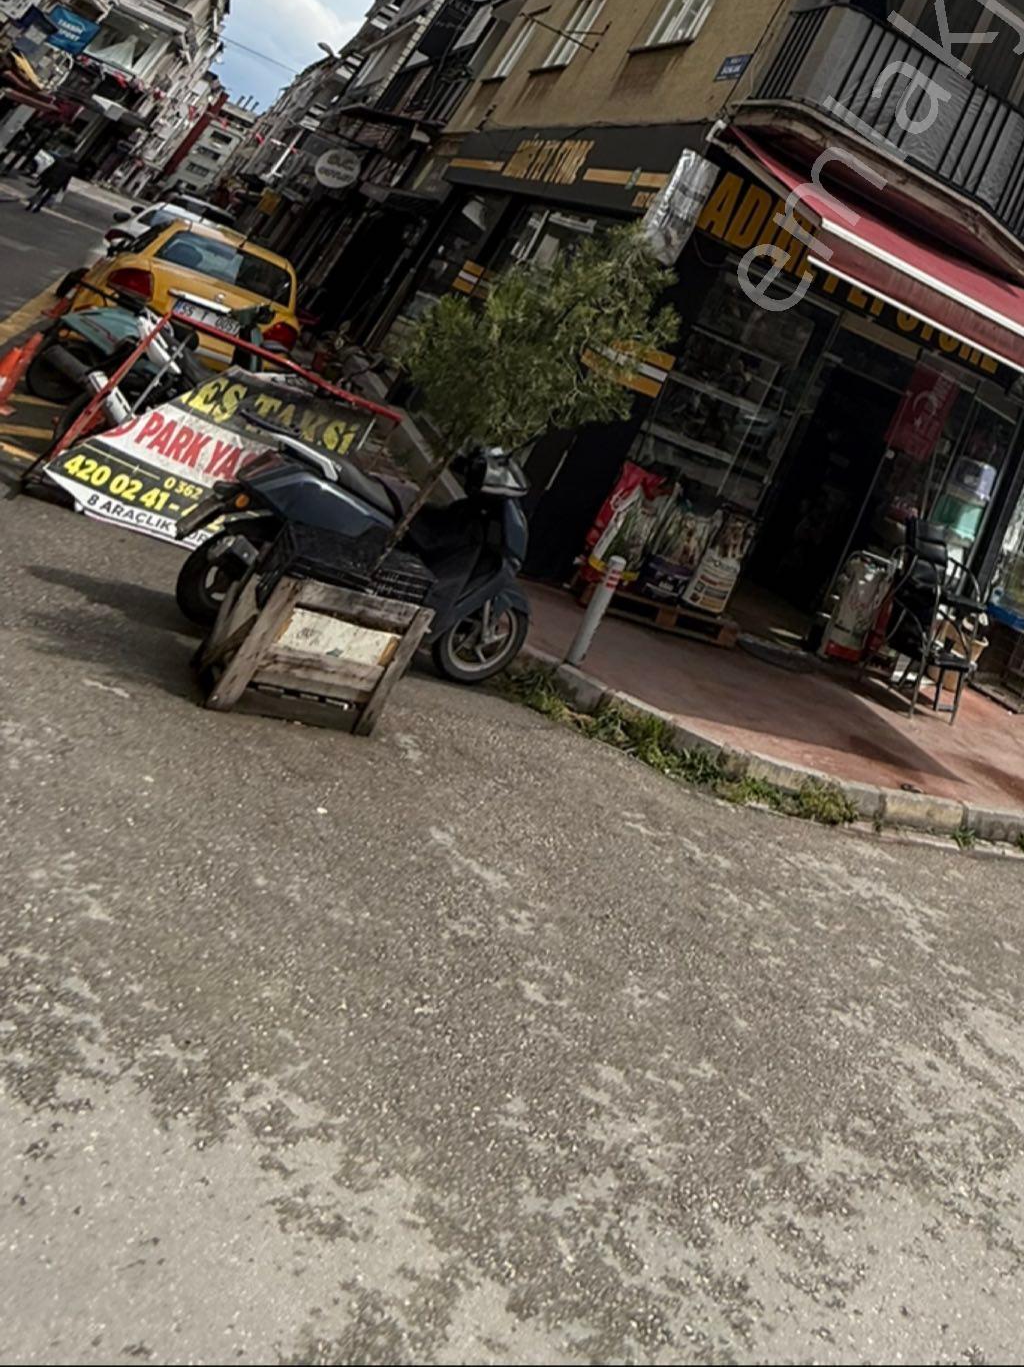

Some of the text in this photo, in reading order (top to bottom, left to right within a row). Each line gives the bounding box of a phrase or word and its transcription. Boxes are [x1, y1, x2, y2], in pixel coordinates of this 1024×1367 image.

[134, 412, 212, 469] PARK
[63, 454, 112, 486] 420
[109, 473, 144, 502] 02
[139, 487, 171, 512] 41
[87, 493, 175, 532] 8 ARAÇLIK
